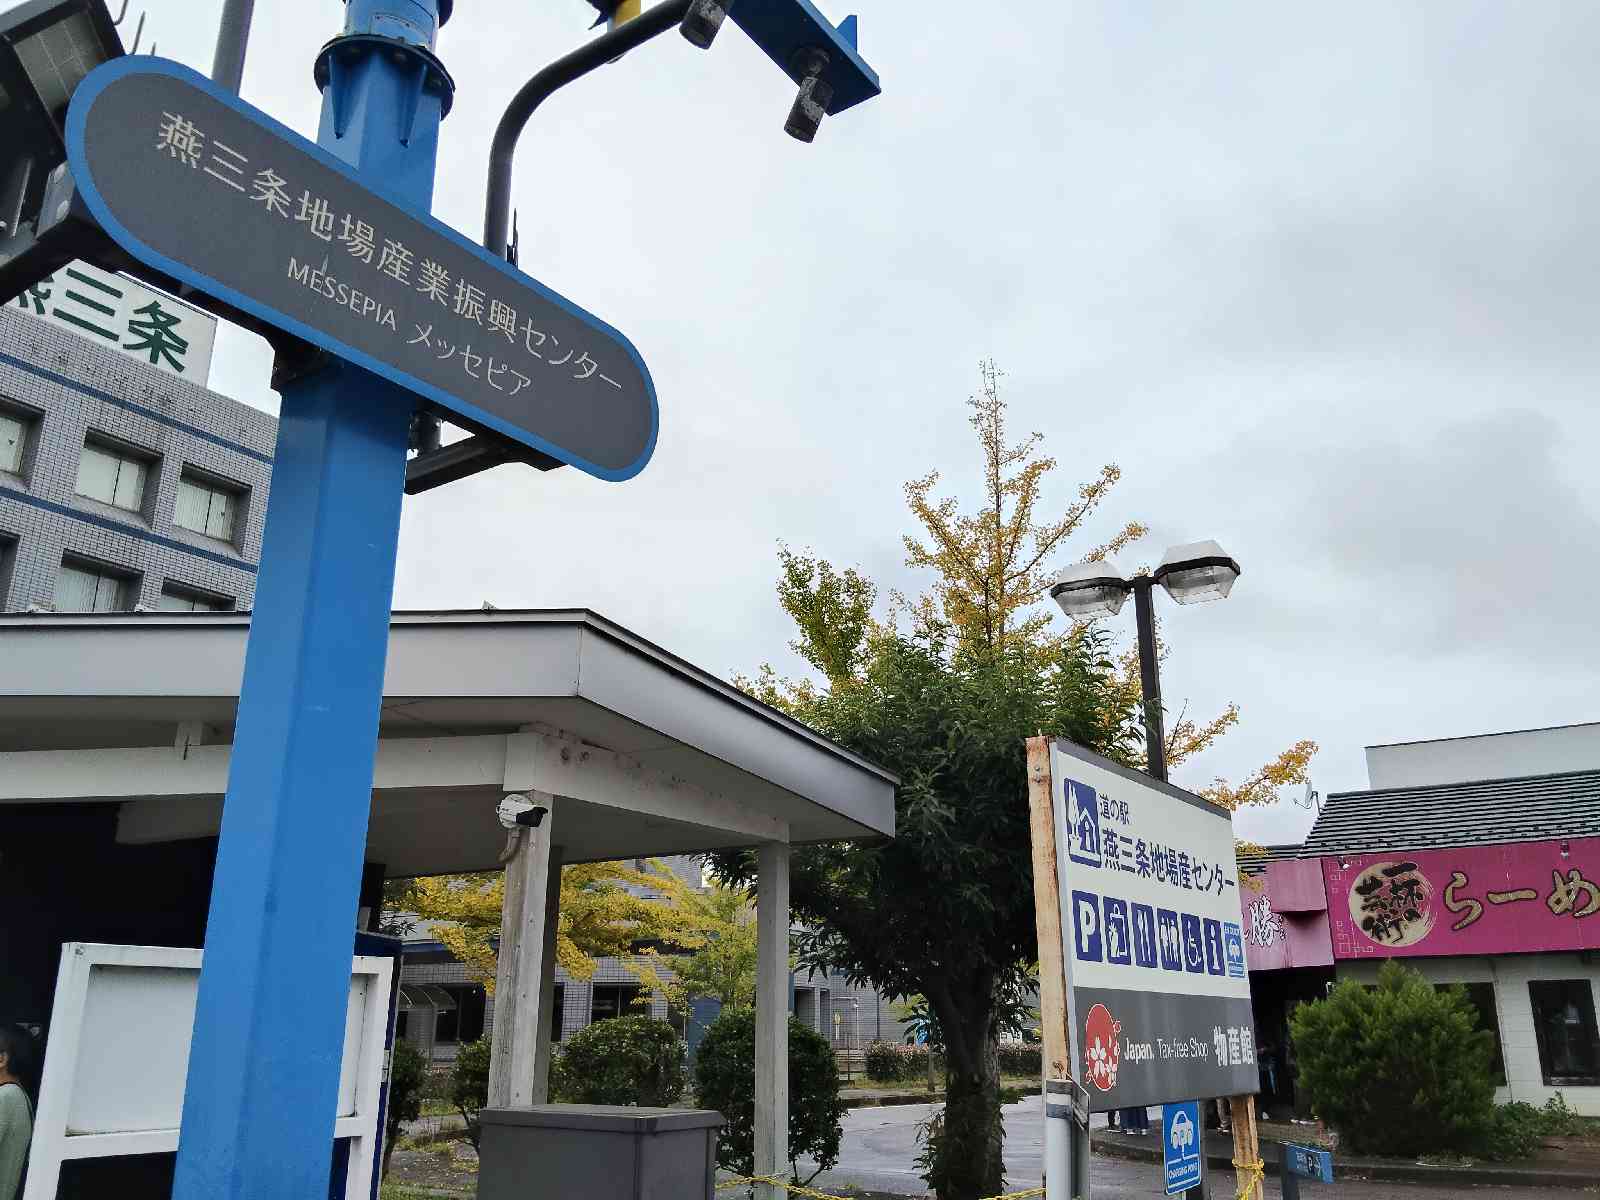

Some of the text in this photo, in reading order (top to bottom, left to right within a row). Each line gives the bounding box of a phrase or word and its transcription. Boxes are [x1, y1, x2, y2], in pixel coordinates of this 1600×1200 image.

[157, 111, 622, 389] 燕三条地場産業振興センター
[287, 256, 532, 396] MESSEPIA メッセピア
[1099, 793, 1130, 825] 道の駅
[1102, 828, 1235, 896] 燕三条地場産センター
[1157, 1038, 1189, 1059] Tax-free
[1189, 1037, 1209, 1062] Shop
[1213, 1025, 1254, 1067] 物産館
